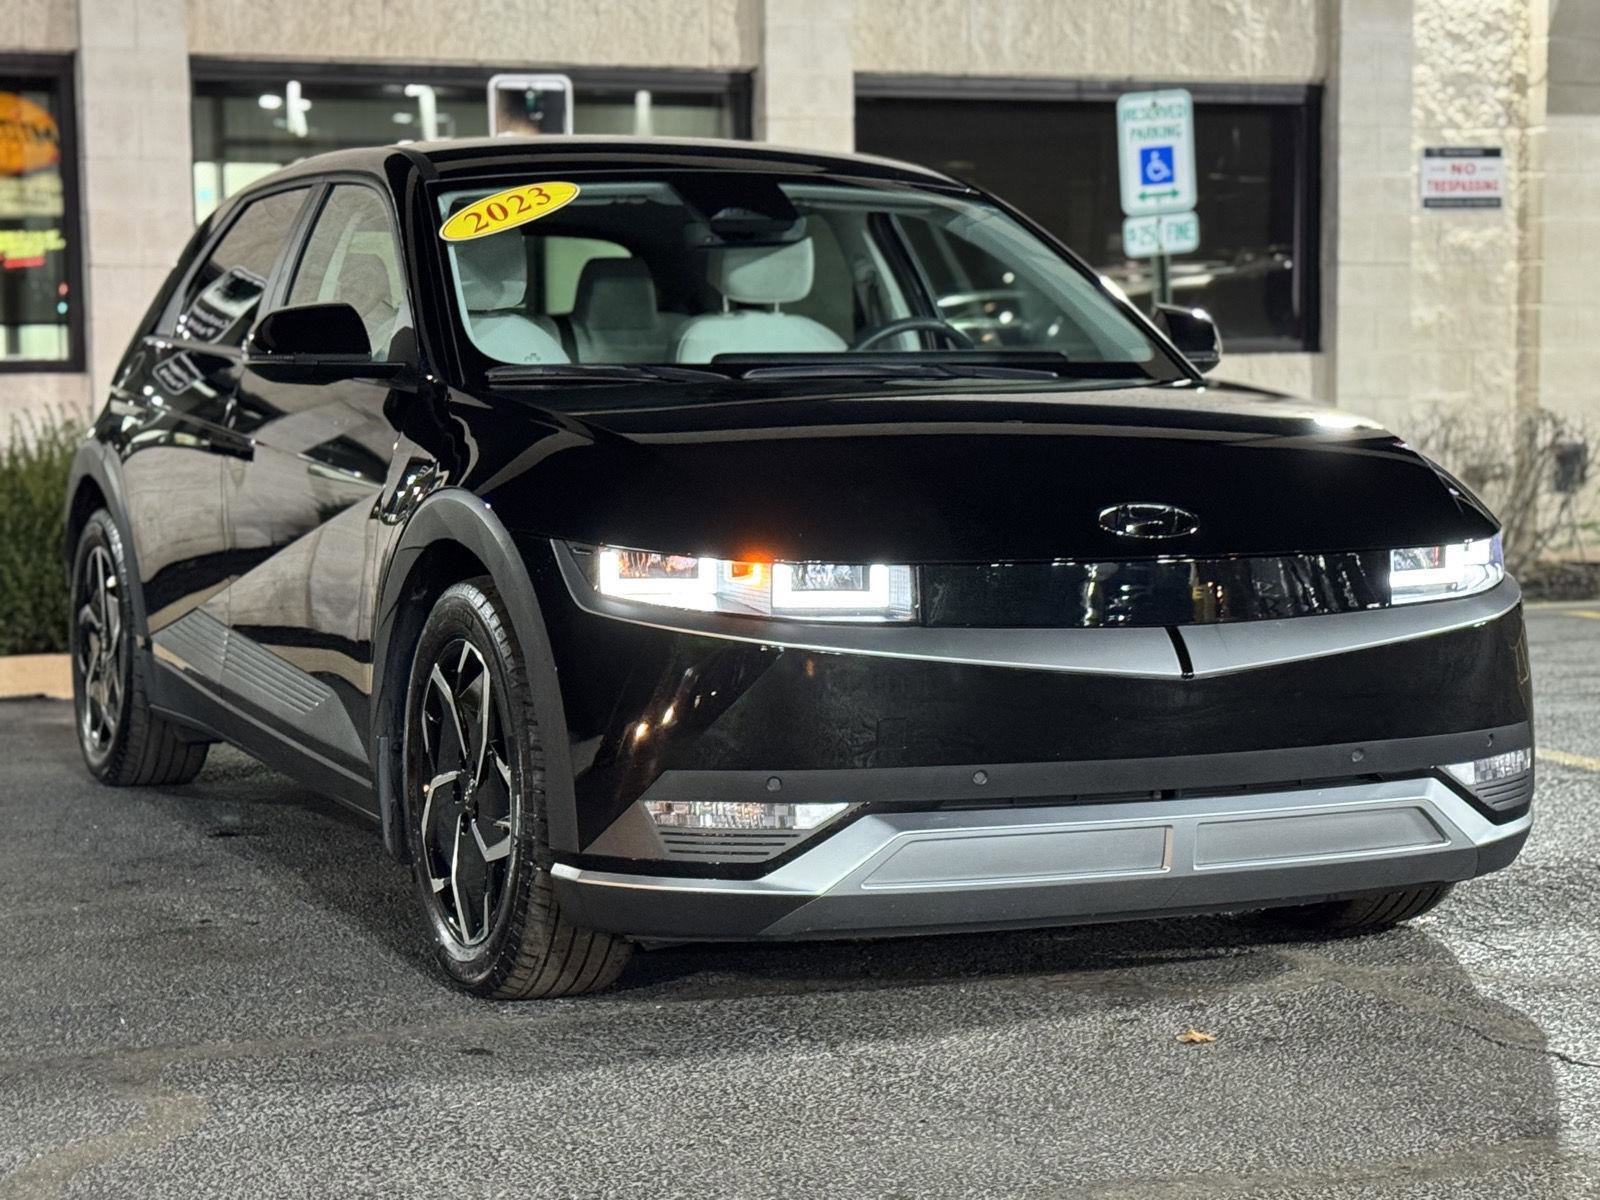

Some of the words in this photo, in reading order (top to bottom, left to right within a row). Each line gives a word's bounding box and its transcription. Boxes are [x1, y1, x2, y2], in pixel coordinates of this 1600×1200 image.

[1130, 123, 1183, 141] PARKING
[1450, 163, 1477, 175] NO
[1427, 180, 1499, 192] TRESPASSING
[463, 186, 552, 233] 2023
[1165, 220, 1195, 242] FINE
